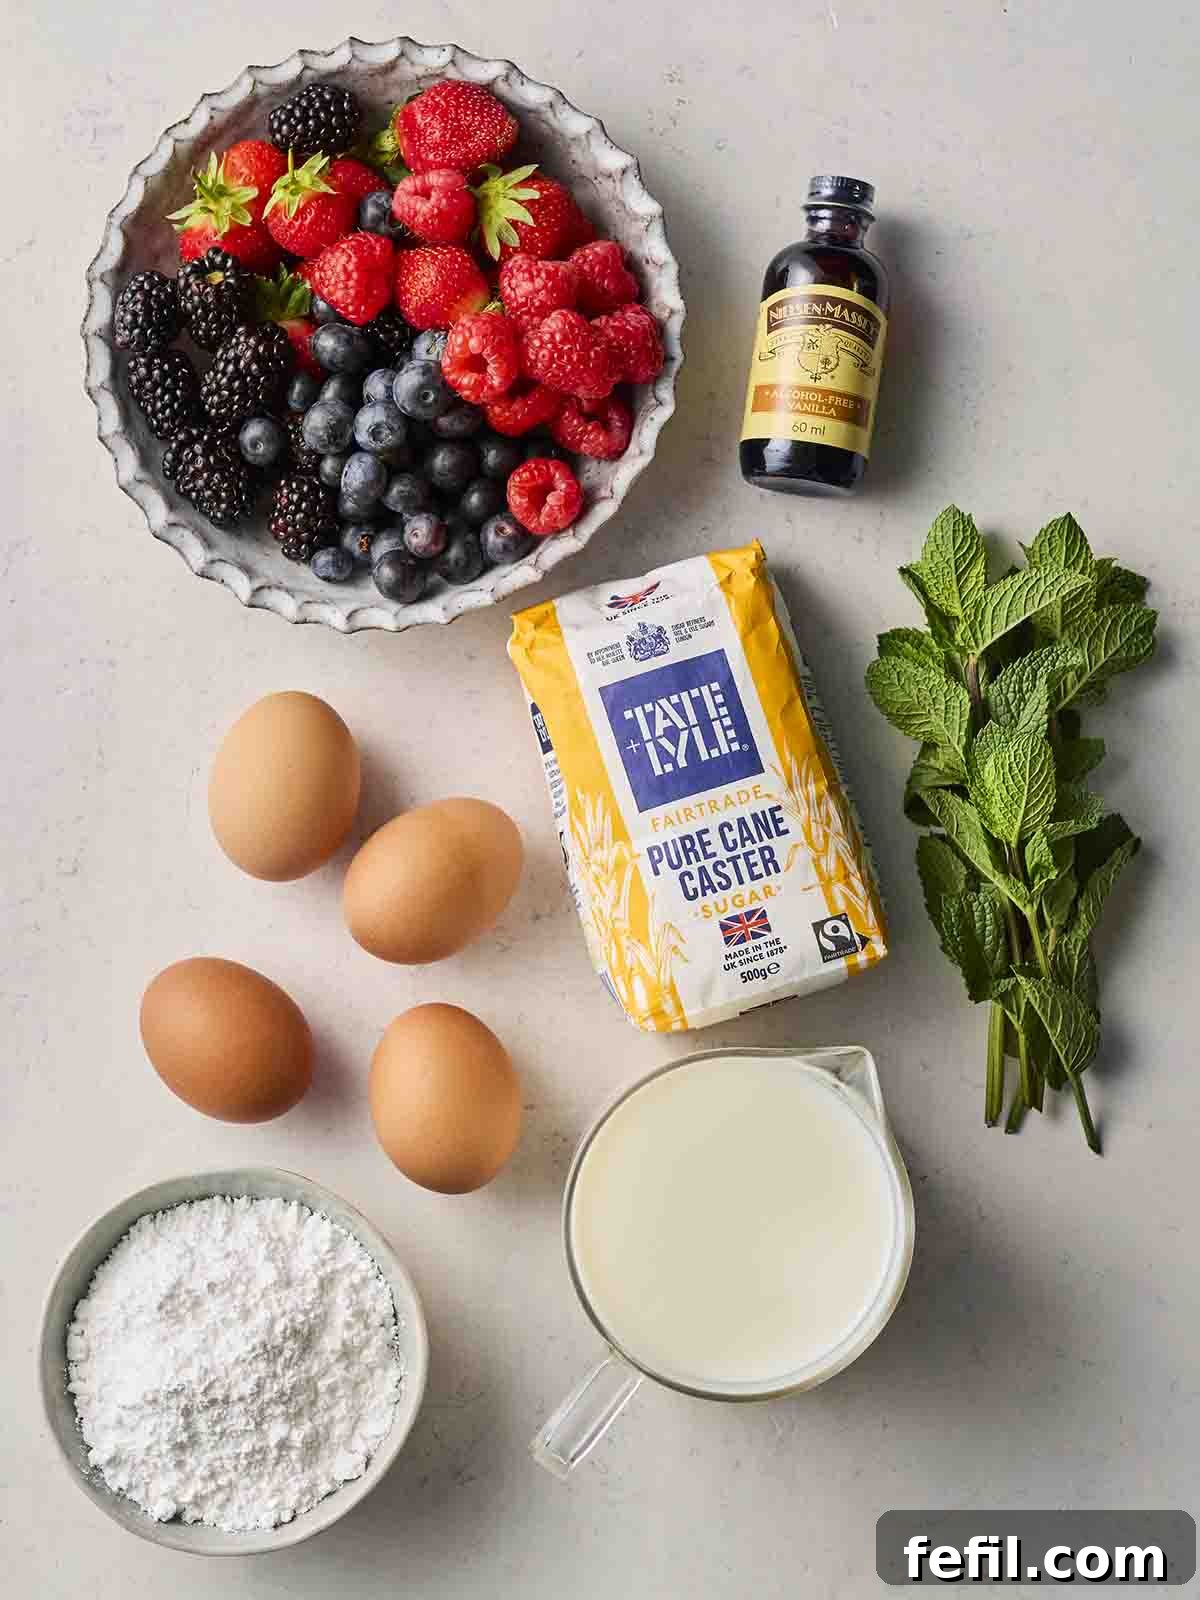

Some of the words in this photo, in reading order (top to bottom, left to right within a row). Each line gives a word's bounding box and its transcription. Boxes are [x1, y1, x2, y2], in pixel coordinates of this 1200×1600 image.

[788, 402, 837, 417] VANILLA
[792, 423, 807, 433] 60
[811, 424, 825, 436] ml
[624, 682, 729, 742] TATE
[651, 784, 764, 833] FAIRTRADE
[646, 828, 717, 877] PURE
[718, 805, 790, 853] CANE
[678, 845, 782, 902] CASTER
[723, 961, 738, 972] UK
[737, 952, 765, 968] SINCE
[725, 946, 751, 961] MADE
[751, 943, 763, 954] IN
[764, 937, 782, 951] THE
